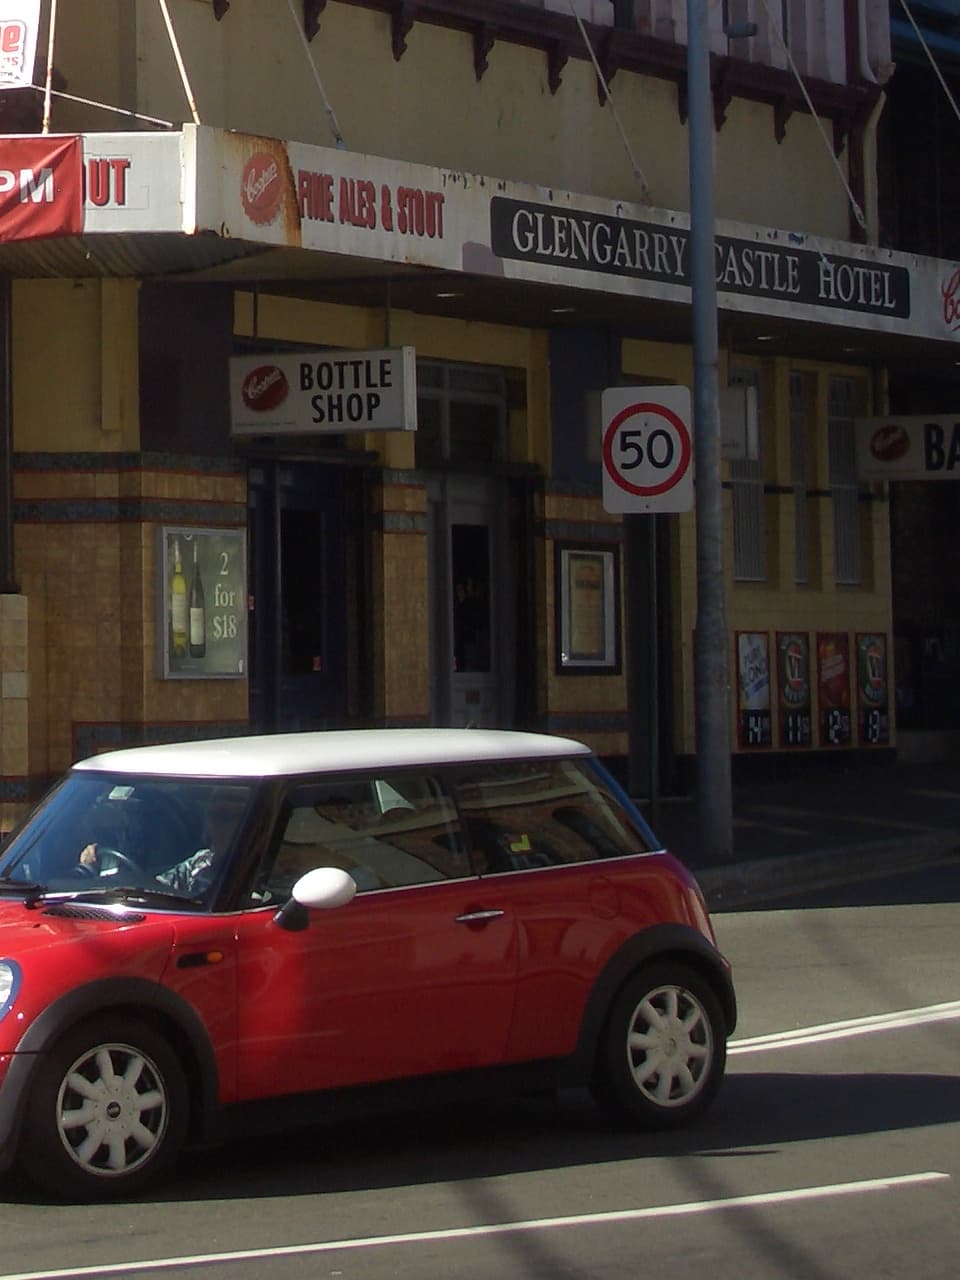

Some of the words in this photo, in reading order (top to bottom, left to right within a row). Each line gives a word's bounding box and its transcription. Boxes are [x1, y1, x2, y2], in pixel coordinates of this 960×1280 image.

[298, 170, 334, 224] FINE
[339, 177, 377, 230] ALES
[380, 184, 394, 232] &
[396, 186, 445, 239] STOUT
[511, 208, 686, 278] GLENGARRY
[817, 259, 896, 309] HOTEL
[300, 359, 393, 391] BOTTLE
[311, 392, 381, 424] SHOP
[619, 428, 674, 470] 50
[220, 552, 230, 576] 2
[214, 583, 236, 607] for
[213, 615, 237, 639] $18
